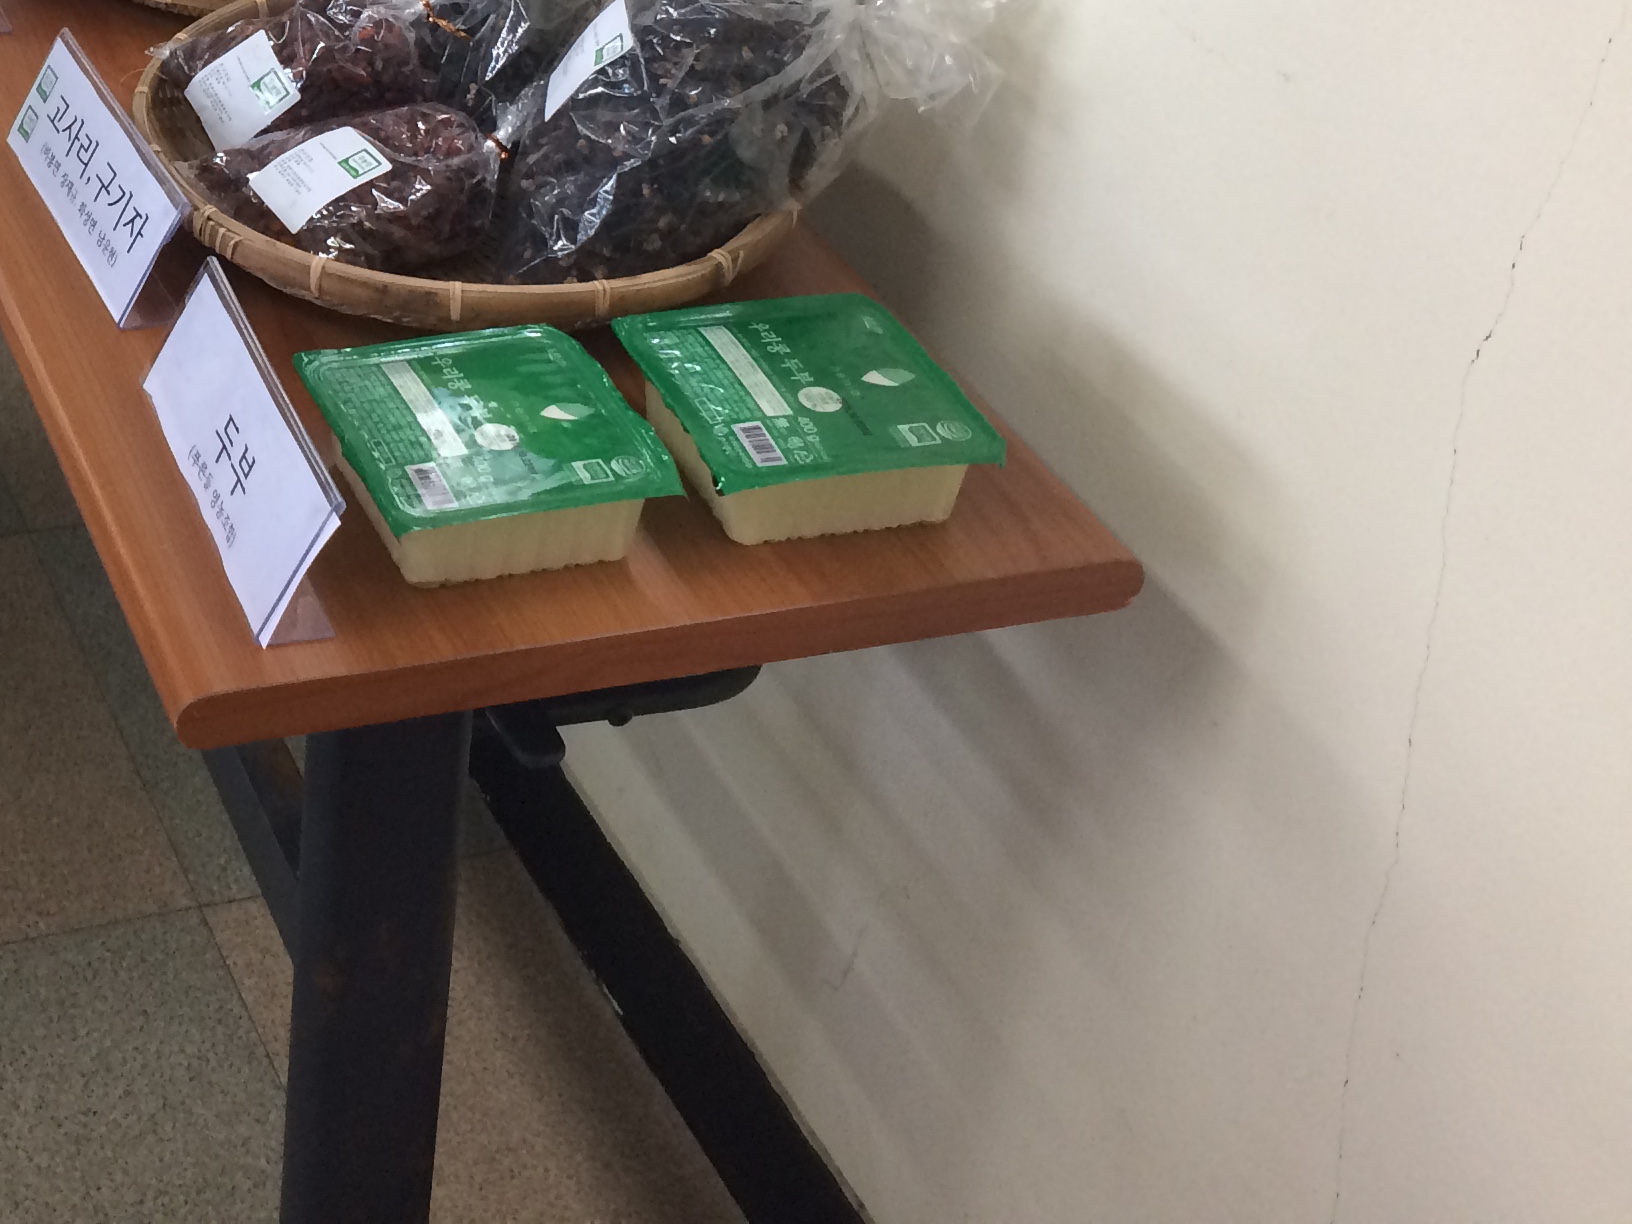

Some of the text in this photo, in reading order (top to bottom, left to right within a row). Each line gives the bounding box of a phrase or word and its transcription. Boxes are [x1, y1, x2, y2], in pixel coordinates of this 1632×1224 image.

[748, 320, 814, 384] 우리콩 두부
[215, 412, 256, 496] 두부
